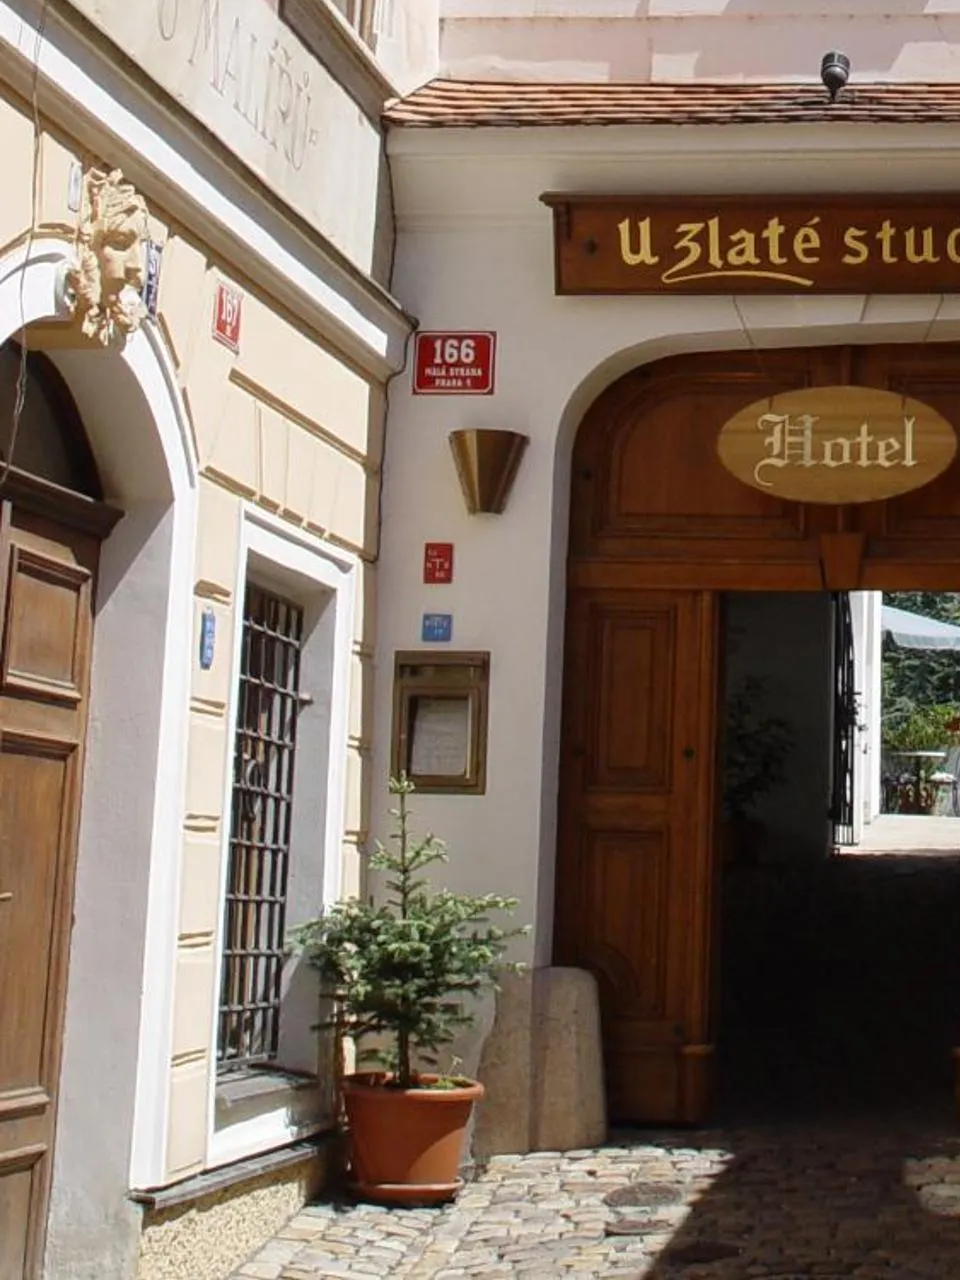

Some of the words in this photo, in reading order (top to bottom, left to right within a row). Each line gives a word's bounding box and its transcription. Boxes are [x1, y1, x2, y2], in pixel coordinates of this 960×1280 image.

[617, 216, 660, 265] U
[433, 338, 476, 364] 166
[754, 413, 918, 487] Hotel
